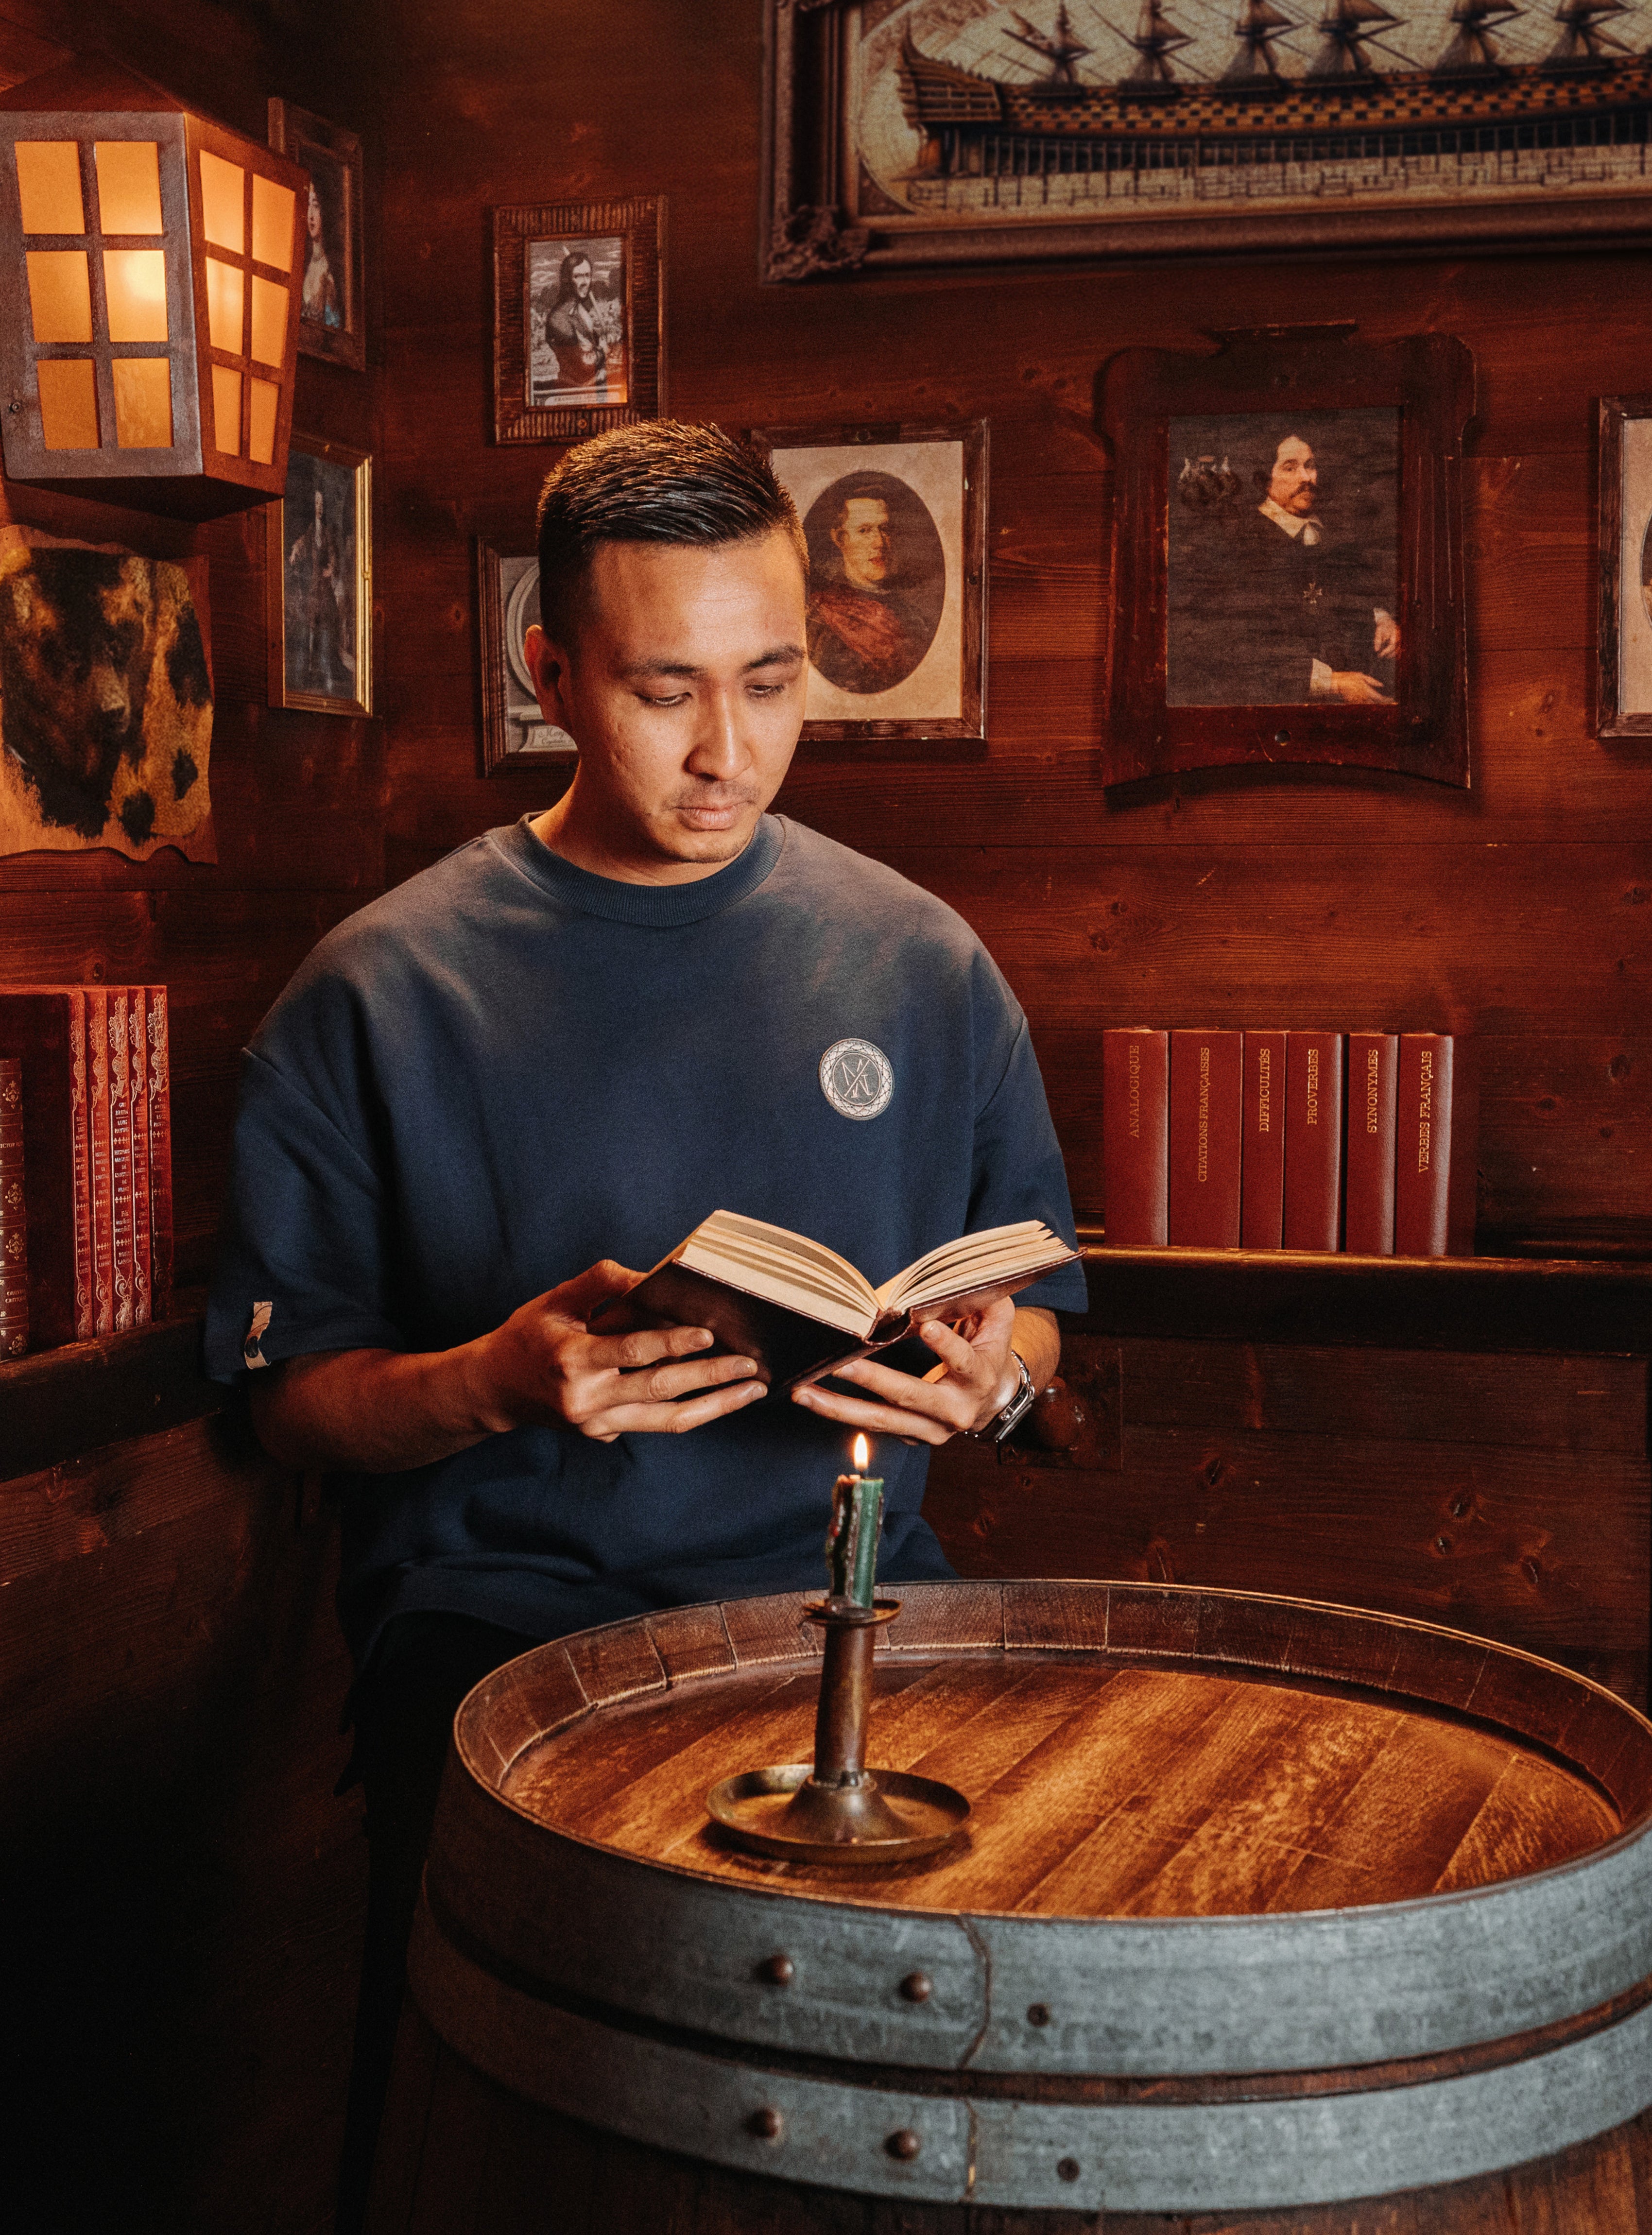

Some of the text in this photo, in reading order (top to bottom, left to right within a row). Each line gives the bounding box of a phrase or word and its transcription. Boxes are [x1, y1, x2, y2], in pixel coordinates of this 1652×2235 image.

[1129, 1044, 1140, 1138] ANALOGIQUE
[1198, 1047, 1210, 1183] CITATIONS FRANÇAISES
[1258, 1048, 1271, 1133] DIFFICULTÉS
[1307, 1049, 1319, 1125] PROVERBES
[1367, 1049, 1378, 1134] SYNONYMES
[1418, 1050, 1433, 1172] VERBES FRANÇAIS
